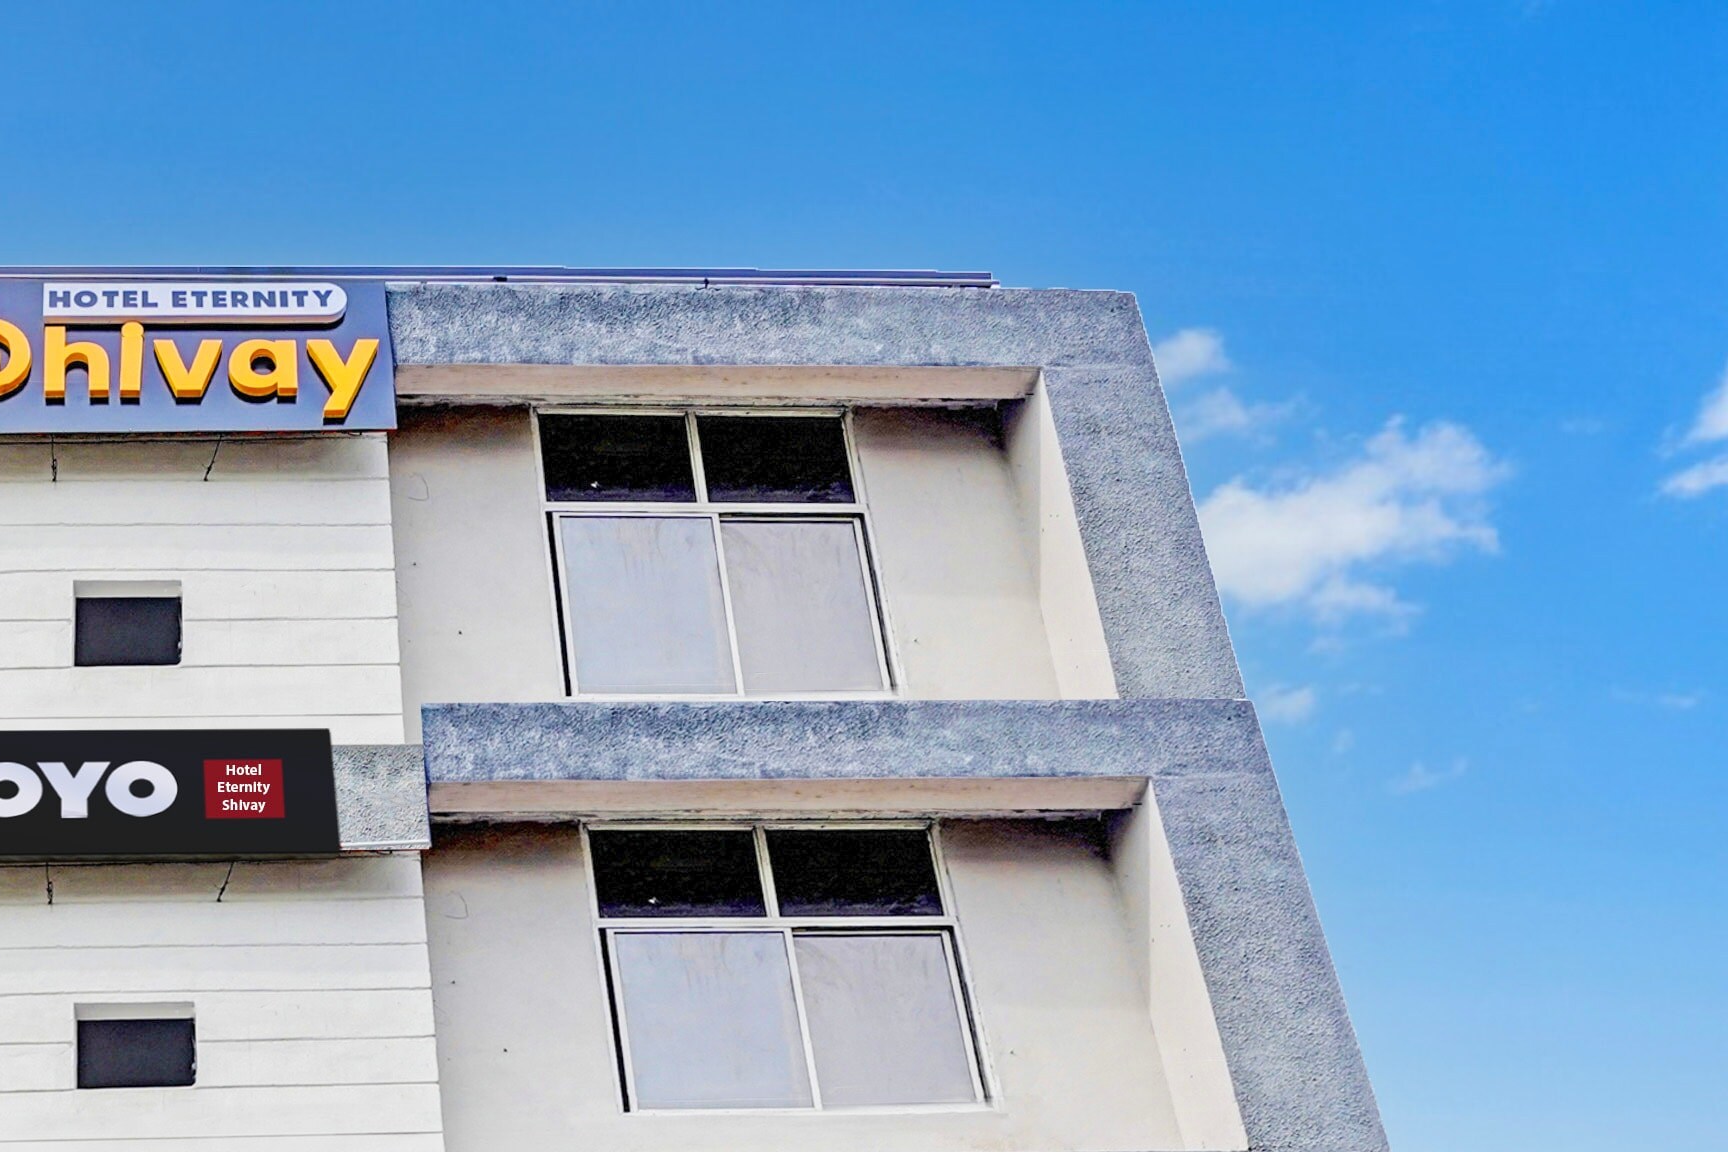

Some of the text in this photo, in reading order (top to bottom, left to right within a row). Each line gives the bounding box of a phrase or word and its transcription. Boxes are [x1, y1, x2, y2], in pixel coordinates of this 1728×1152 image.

[48, 289, 334, 309] HOTEL ETERNITY
[225, 763, 262, 776] Hotel
[217, 781, 271, 795] Eternity
[221, 798, 266, 813] Shivay
